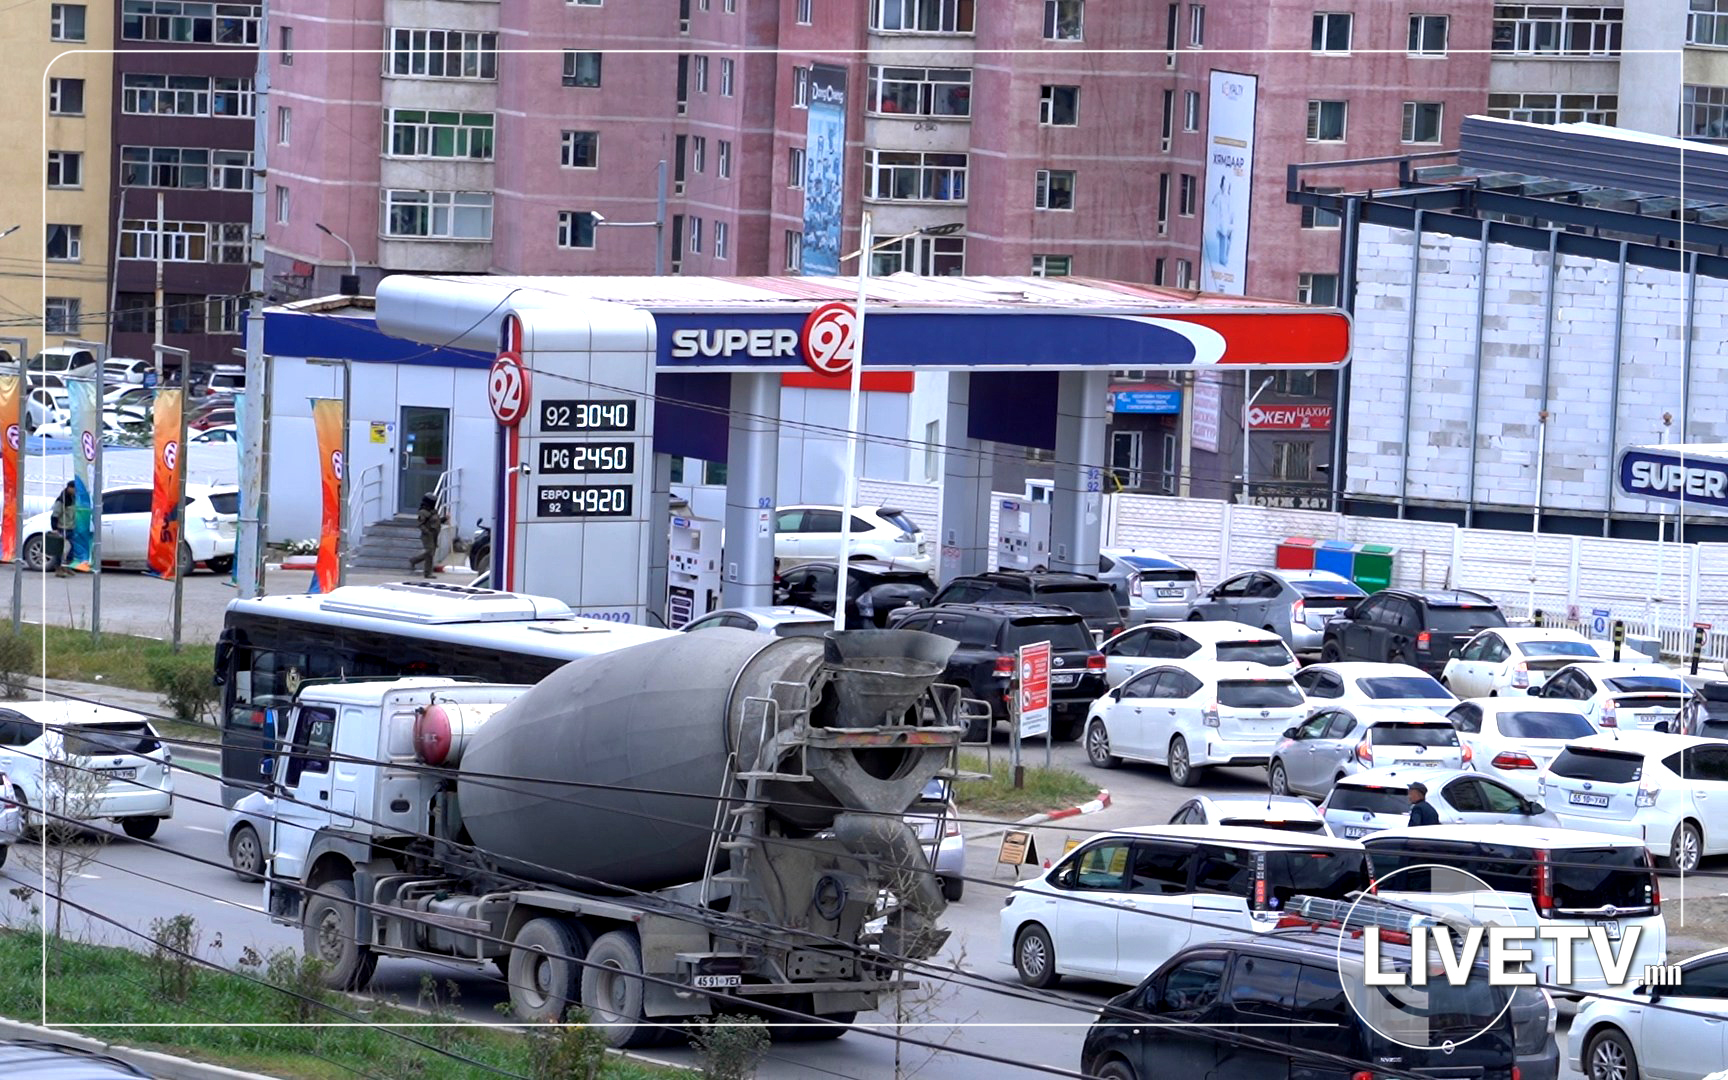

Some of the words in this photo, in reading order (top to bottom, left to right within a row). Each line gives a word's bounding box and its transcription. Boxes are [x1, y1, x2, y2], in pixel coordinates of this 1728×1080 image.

[671, 329, 799, 358] SUPER
[491, 362, 520, 414] 92
[545, 406, 571, 427] 92
[576, 404, 628, 428] 3040
[543, 449, 570, 469] LPG
[573, 446, 627, 470] 2450
[1086, 481, 1099, 492] 92
[1631, 460, 1727, 498] SUPER
[541, 489, 570, 500] ЕВРО
[572, 488, 625, 512] 4920
[548, 502, 562, 513] 92
[758, 497, 771, 508] 92
